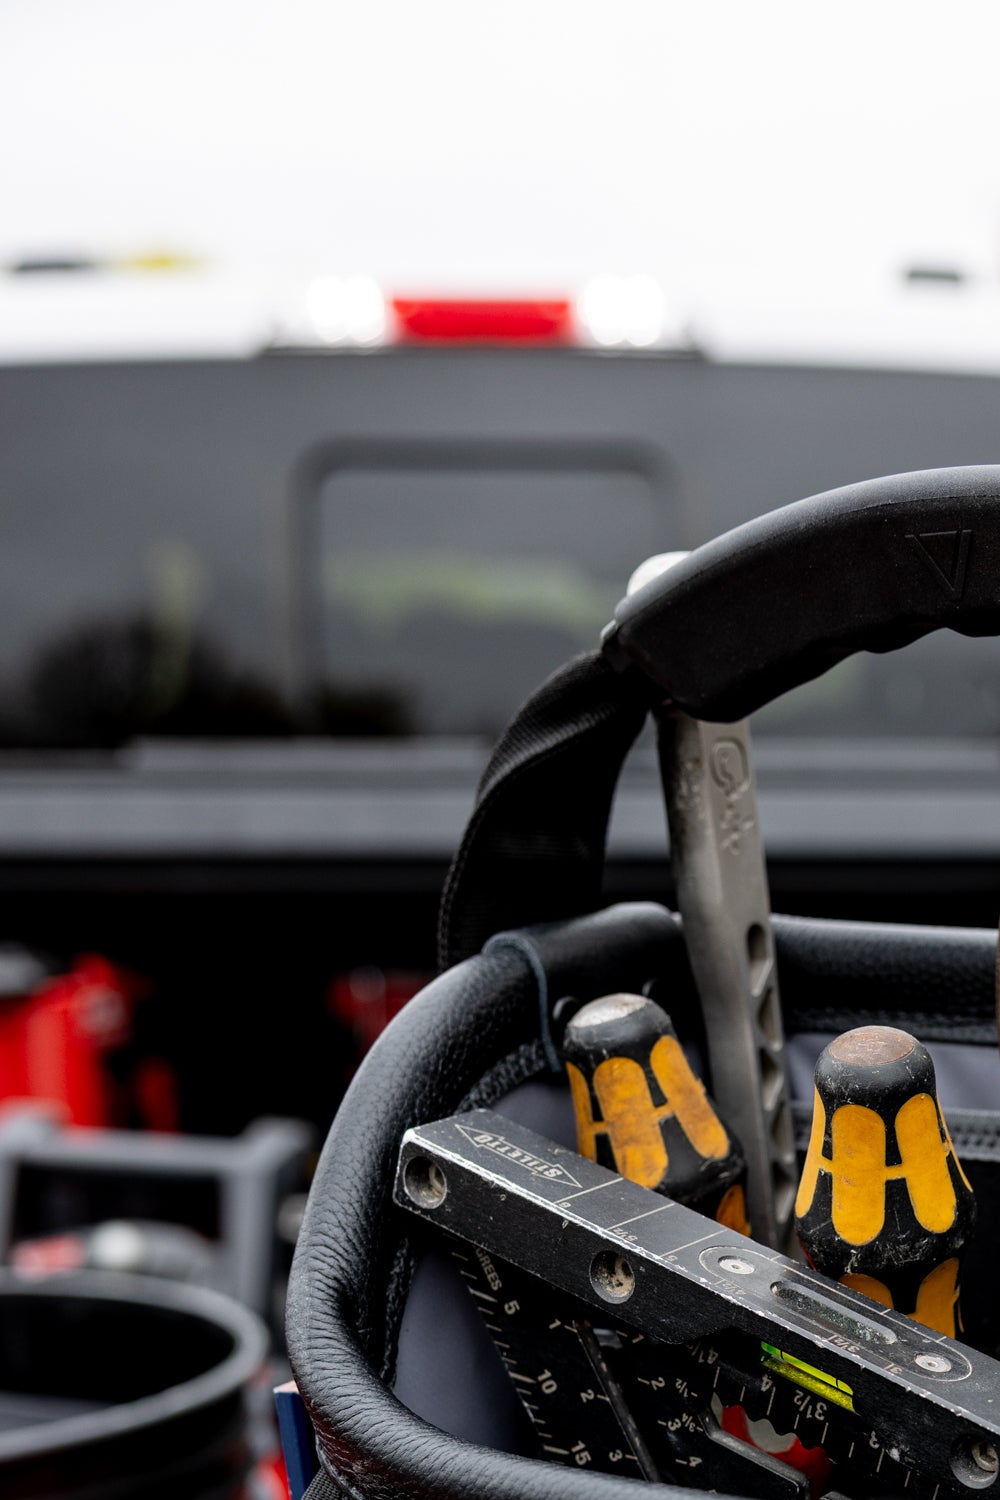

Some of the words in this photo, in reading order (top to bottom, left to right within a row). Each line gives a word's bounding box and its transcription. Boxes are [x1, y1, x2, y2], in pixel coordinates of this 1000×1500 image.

[473, 1134, 564, 1178] STILETTO
[559, 1201, 572, 1209] 6
[667, 1254, 678, 1262] 5
[475, 1248, 502, 1291] GREES
[504, 1300, 520, 1315] 5
[549, 1319, 561, 1330] 1
[632, 1333, 645, 1343] 1
[537, 1369, 558, 1394] 10
[651, 1377, 665, 1391] 2
[760, 1374, 774, 1392] 4
[580, 1389, 595, 1402] 2
[668, 1419, 682, 1431] 3
[868, 1430, 880, 1449] 3
[571, 1440, 592, 1465] 15
[609, 1450, 622, 1462] 3
[686, 1456, 703, 1468] 4
